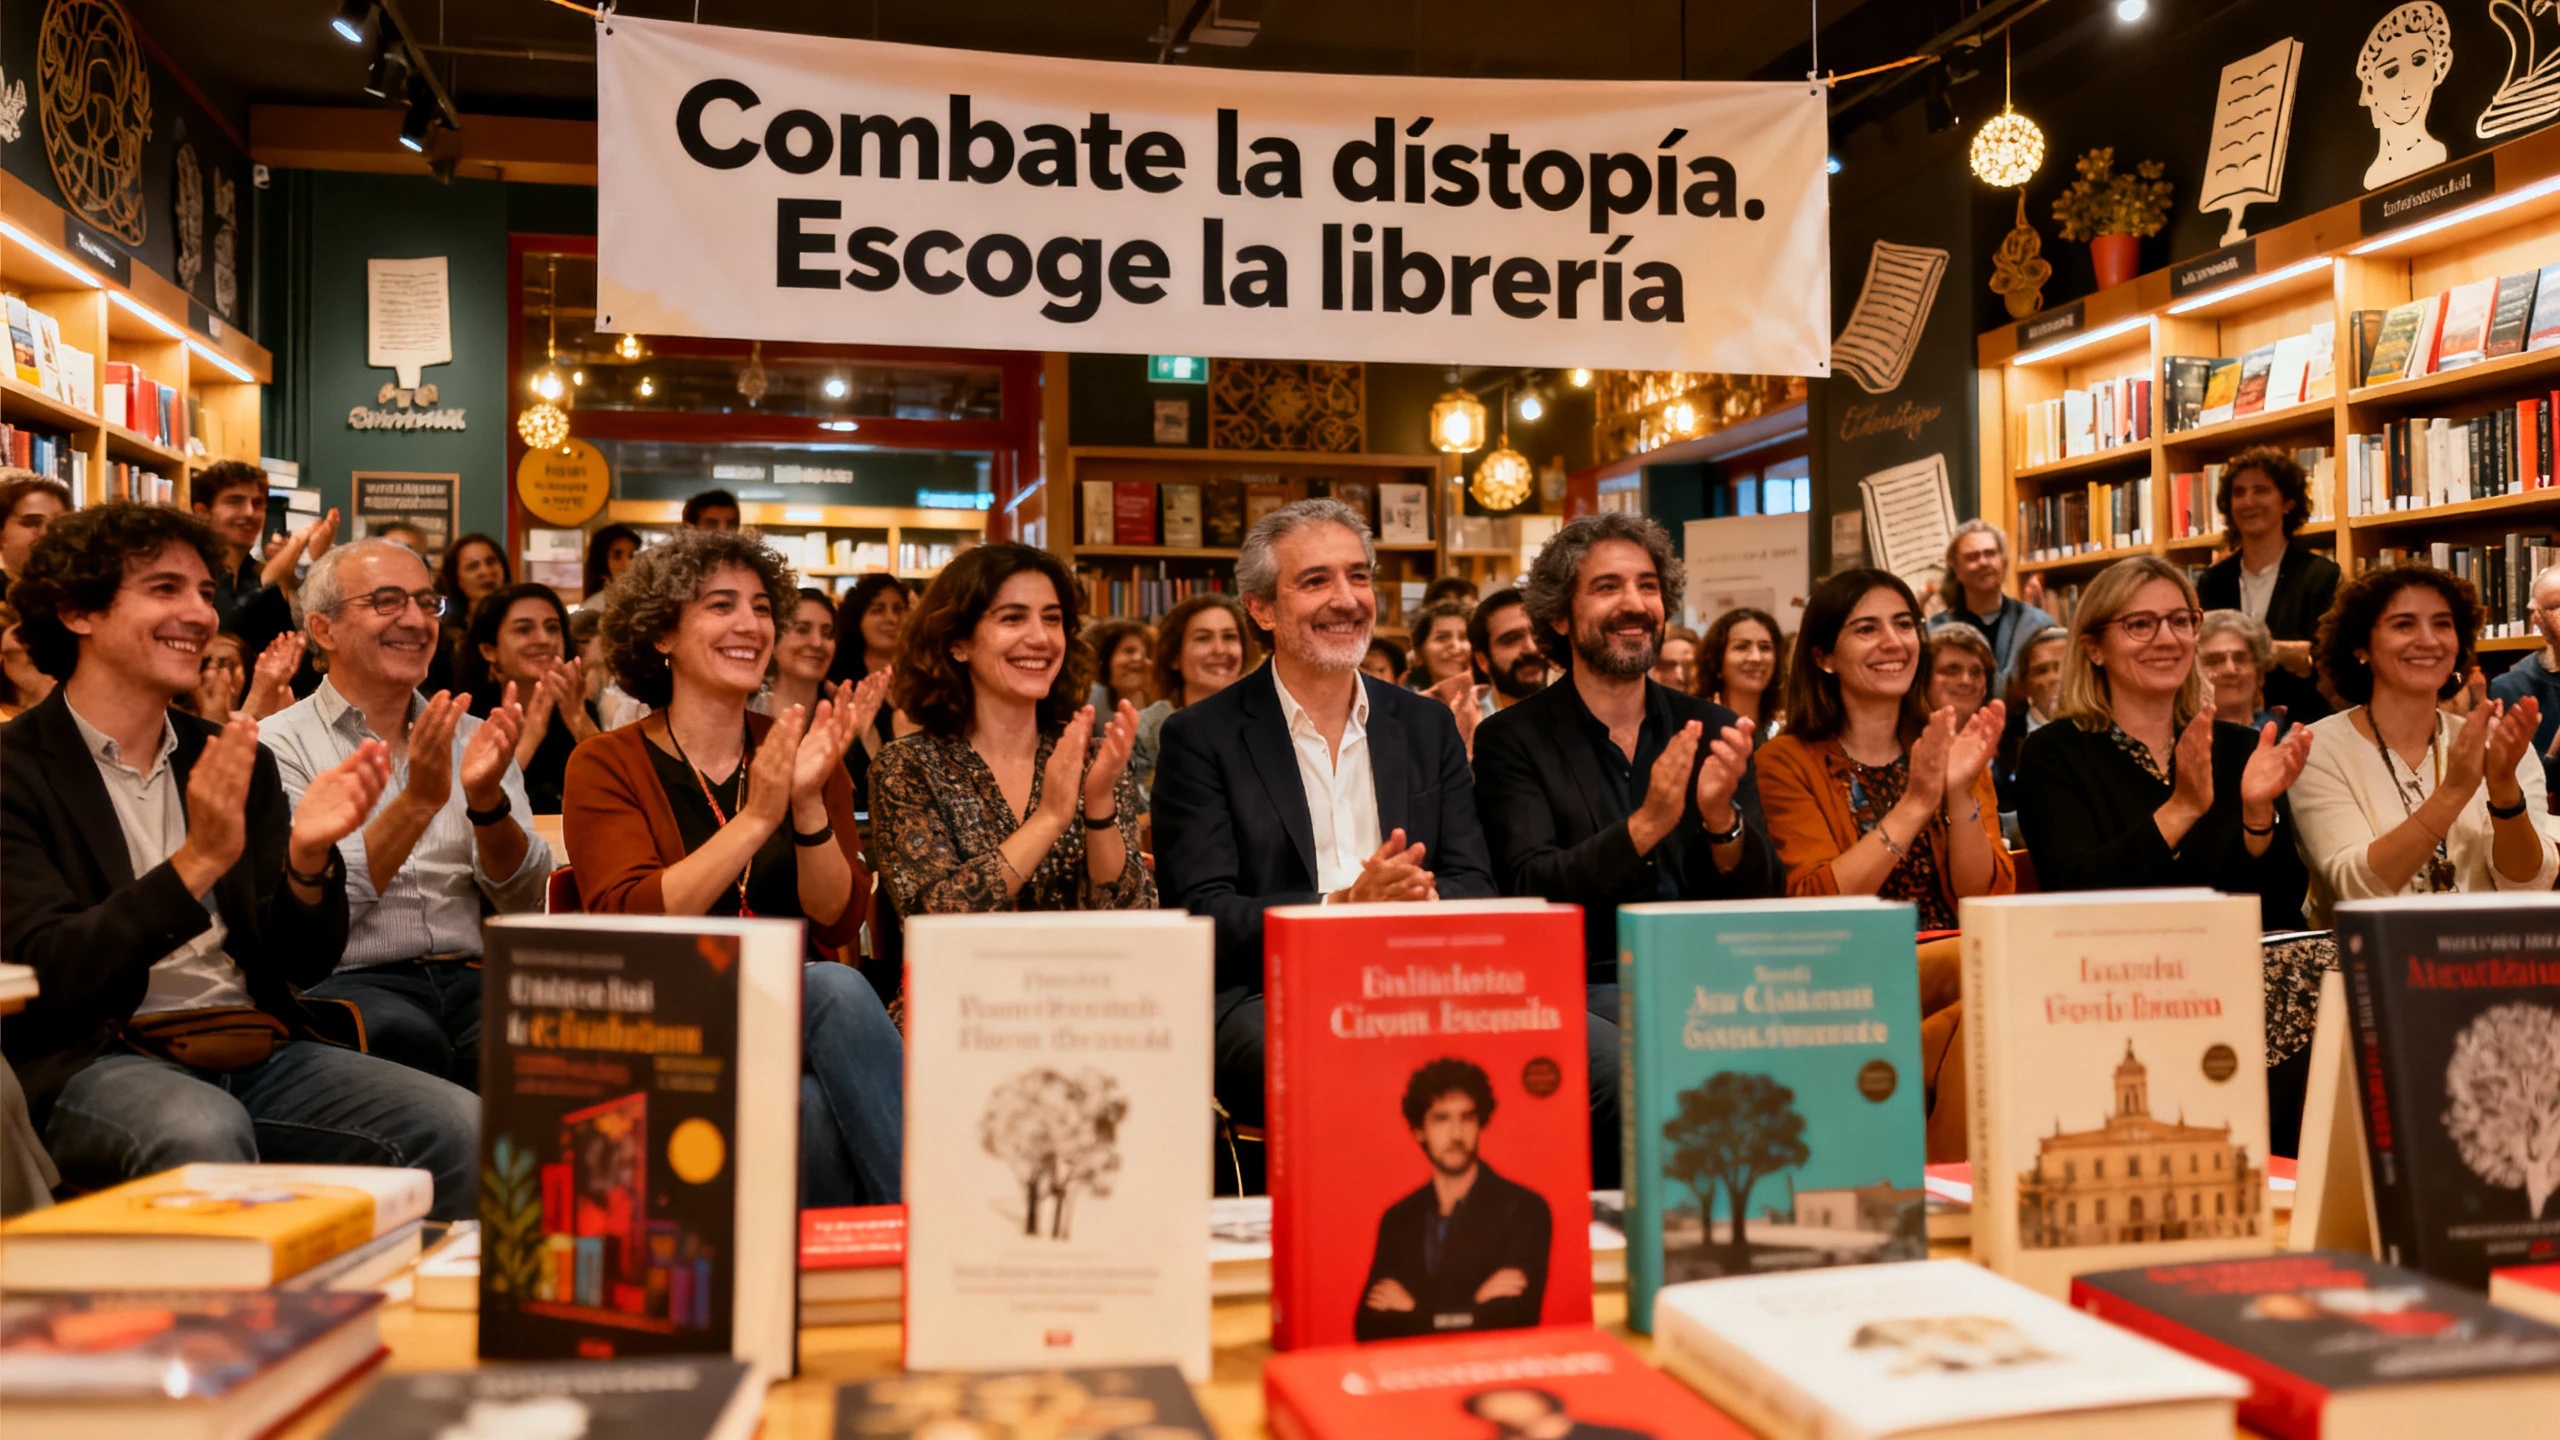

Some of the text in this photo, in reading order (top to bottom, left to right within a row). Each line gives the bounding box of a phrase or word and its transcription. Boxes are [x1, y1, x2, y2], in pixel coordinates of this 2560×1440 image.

[675, 78, 1766, 235] Combate la dístopía.
[776, 197, 1685, 324] Escoge la librería
